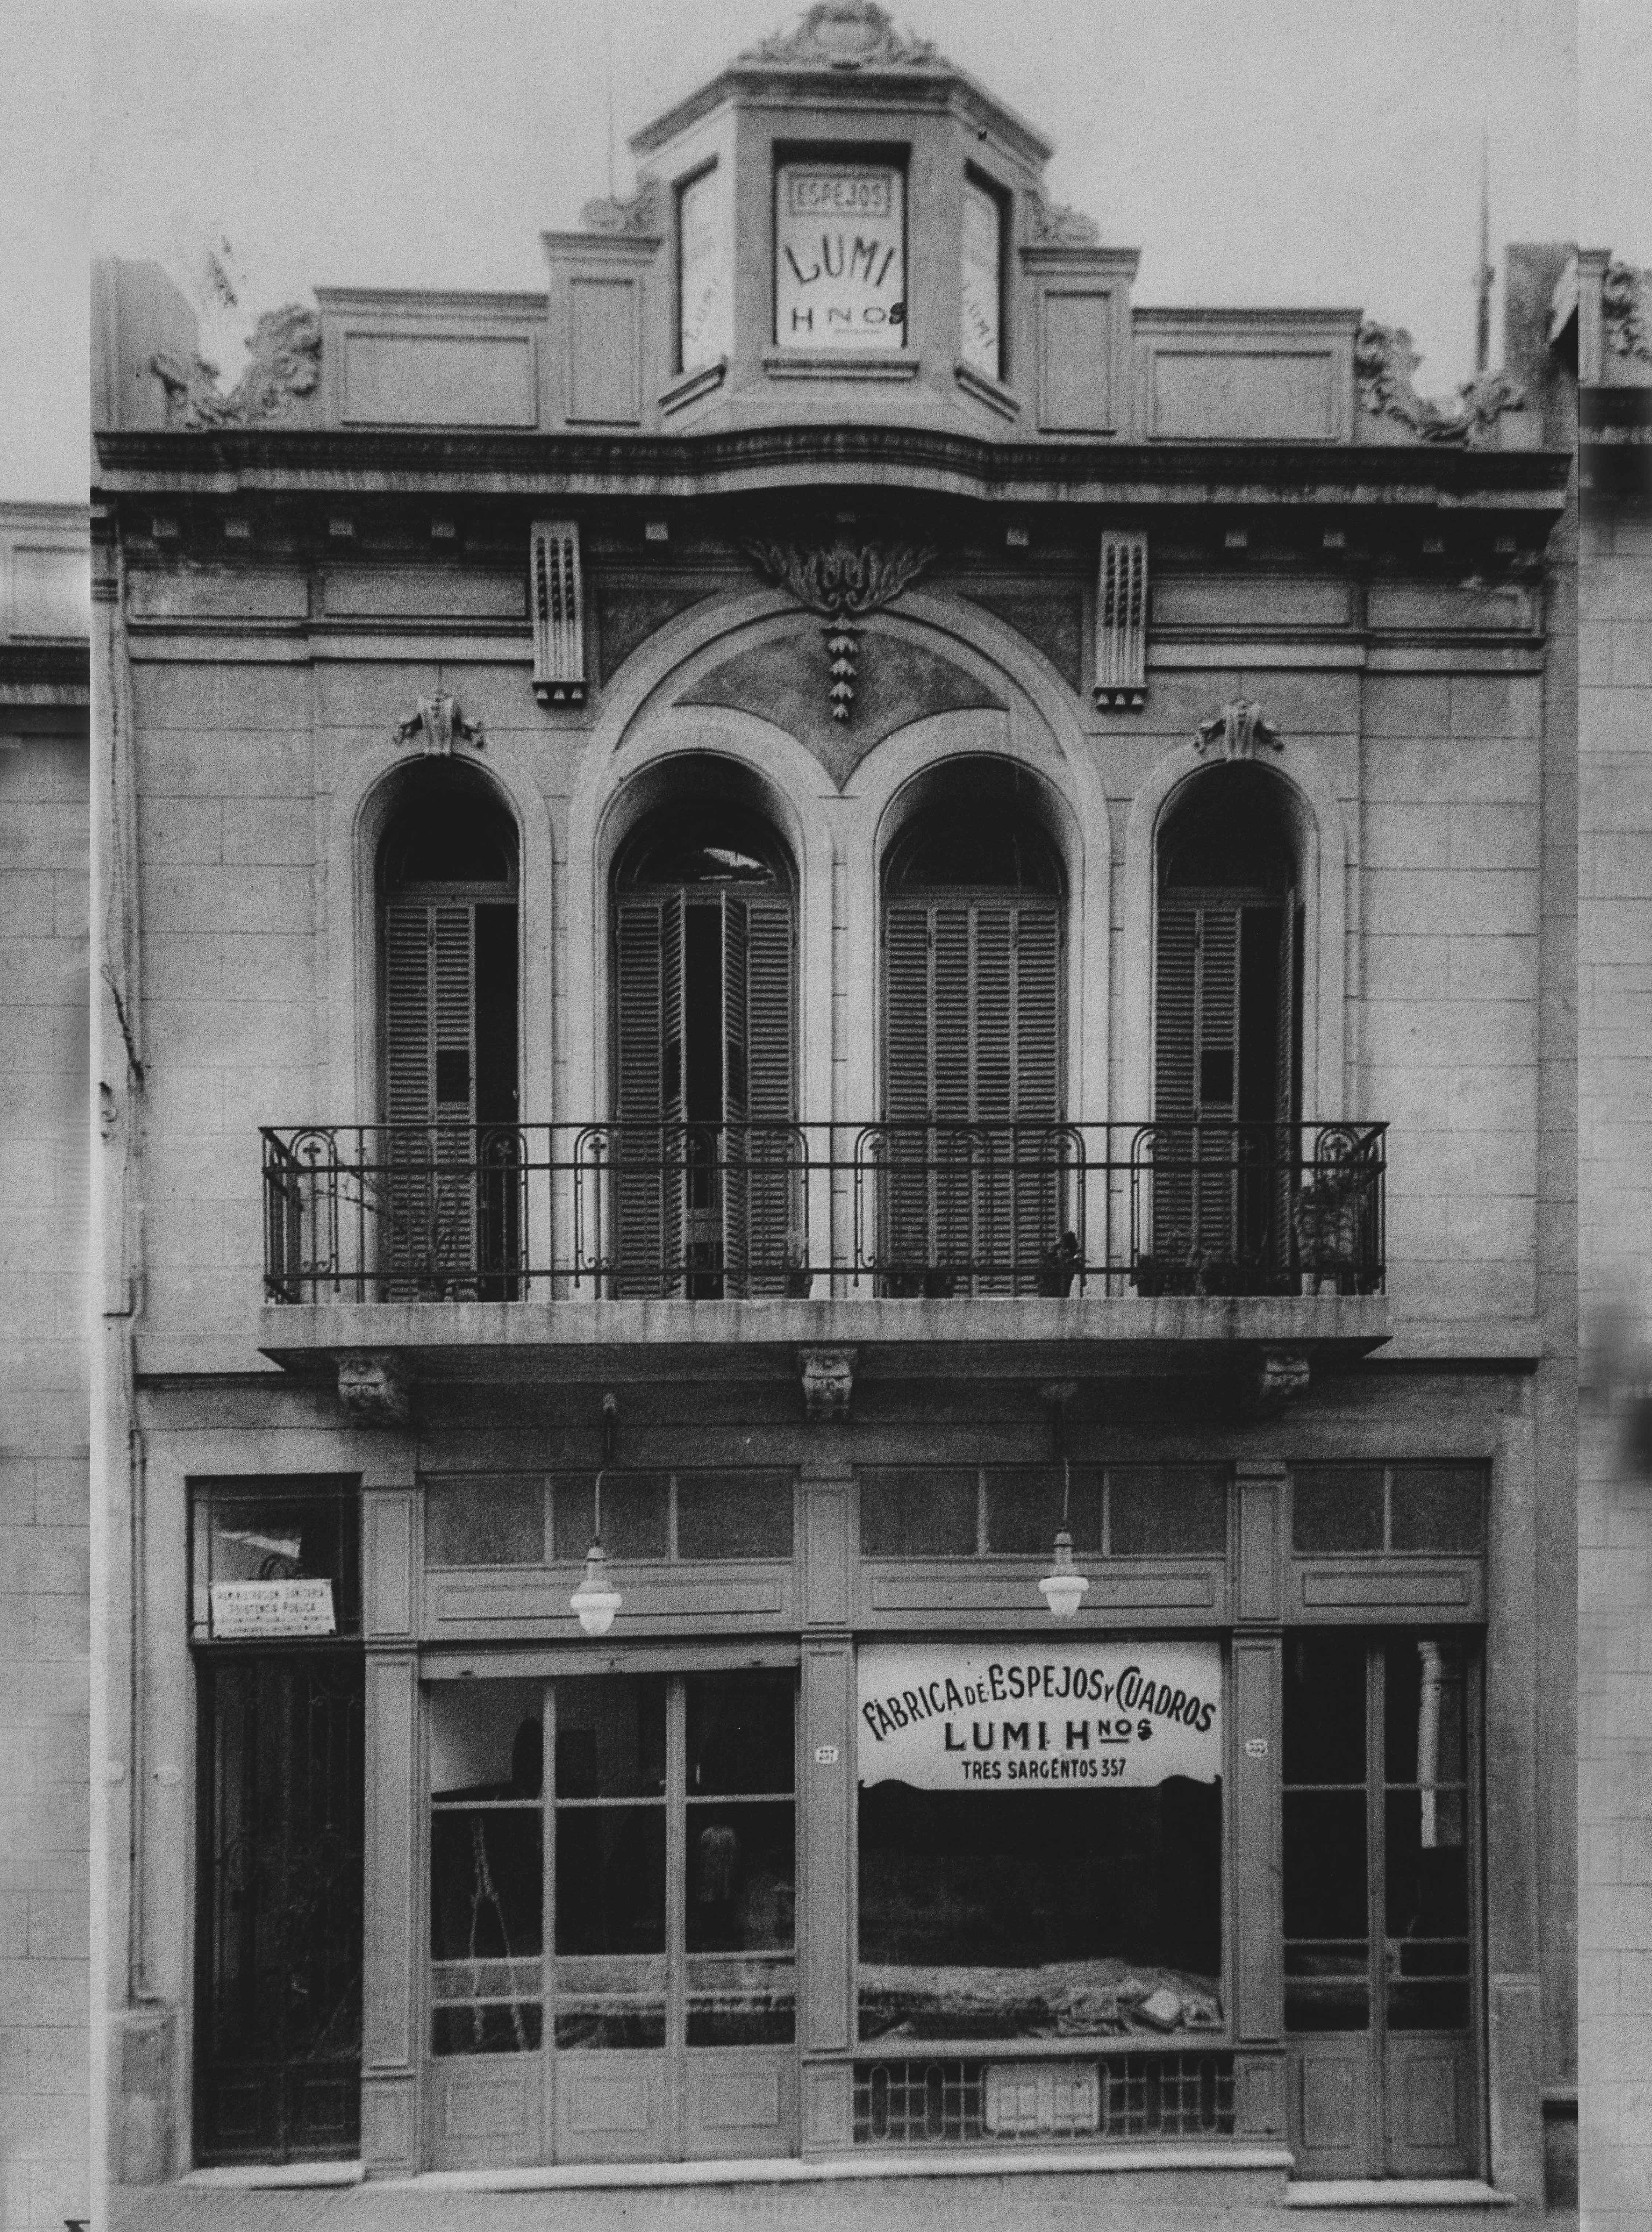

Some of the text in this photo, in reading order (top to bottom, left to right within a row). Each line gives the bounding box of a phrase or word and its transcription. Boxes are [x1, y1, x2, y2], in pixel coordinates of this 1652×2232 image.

[796, 181, 882, 207] ESPEJOS
[784, 234, 895, 288] LUMI
[989, 1663, 1104, 1700] ESPEJOS
[1116, 1666, 1216, 1732] CUADROS
[944, 1721, 1047, 1751] LUMI
[962, 1760, 1002, 1780] TRES
[1101, 1757, 1126, 1778] 357
